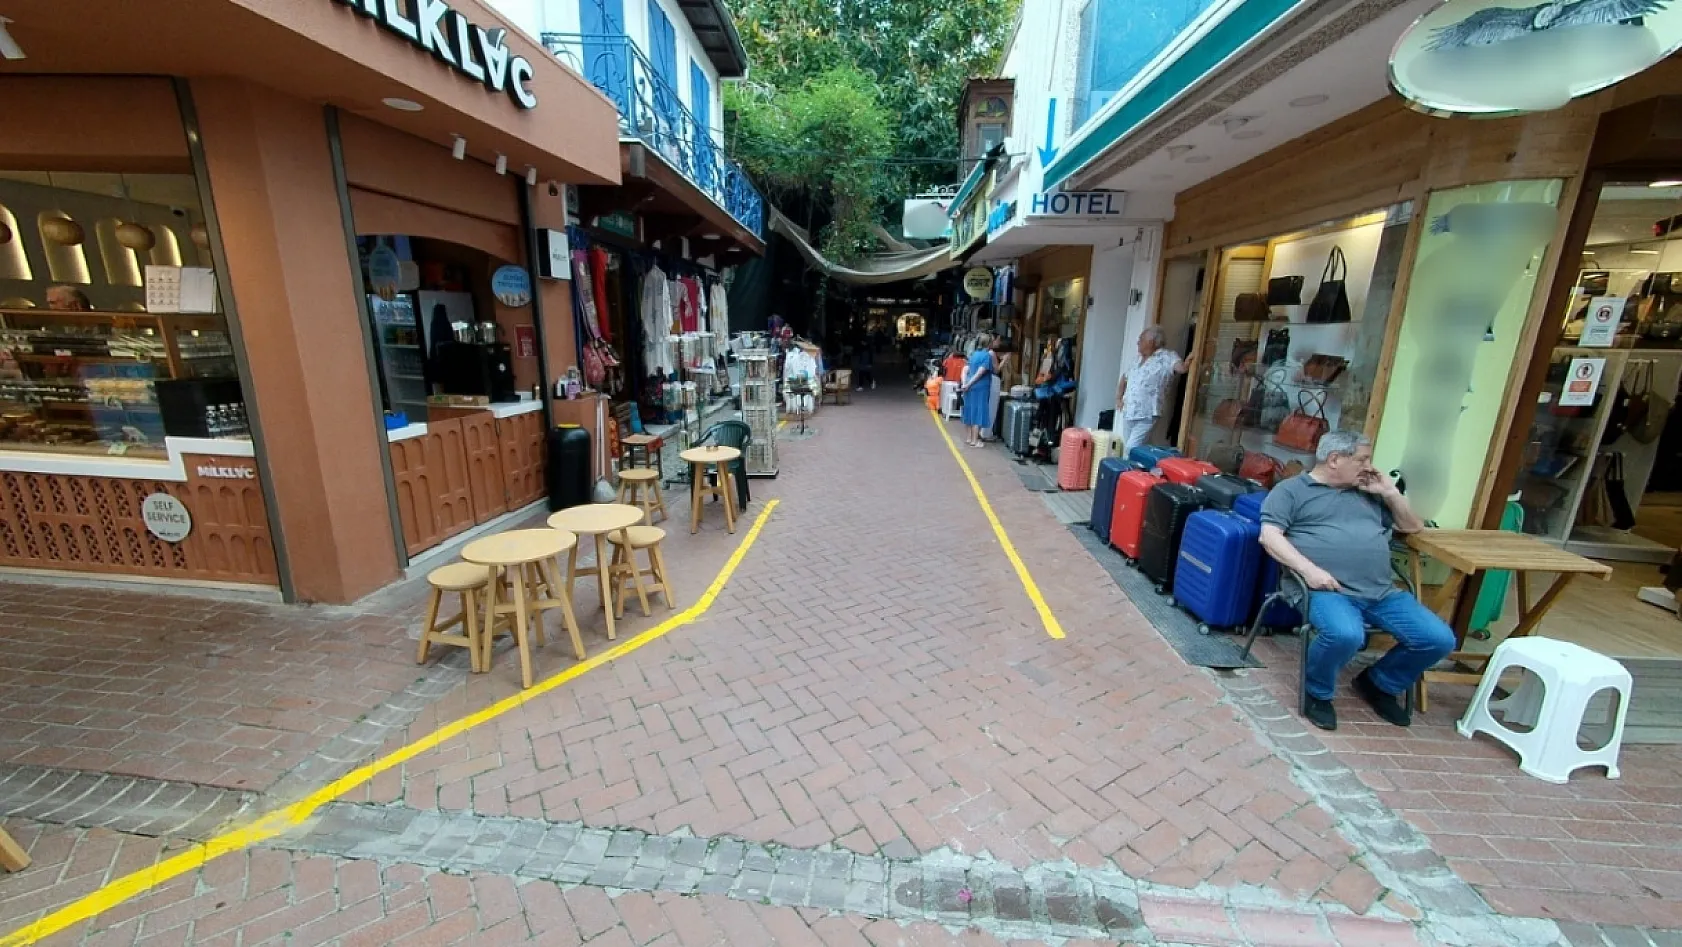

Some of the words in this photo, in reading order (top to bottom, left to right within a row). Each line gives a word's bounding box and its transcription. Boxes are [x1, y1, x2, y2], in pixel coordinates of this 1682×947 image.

[1032, 192, 1120, 215] HOTEL
[153, 500, 173, 512] SELF
[147, 511, 186, 524] SERVICE
